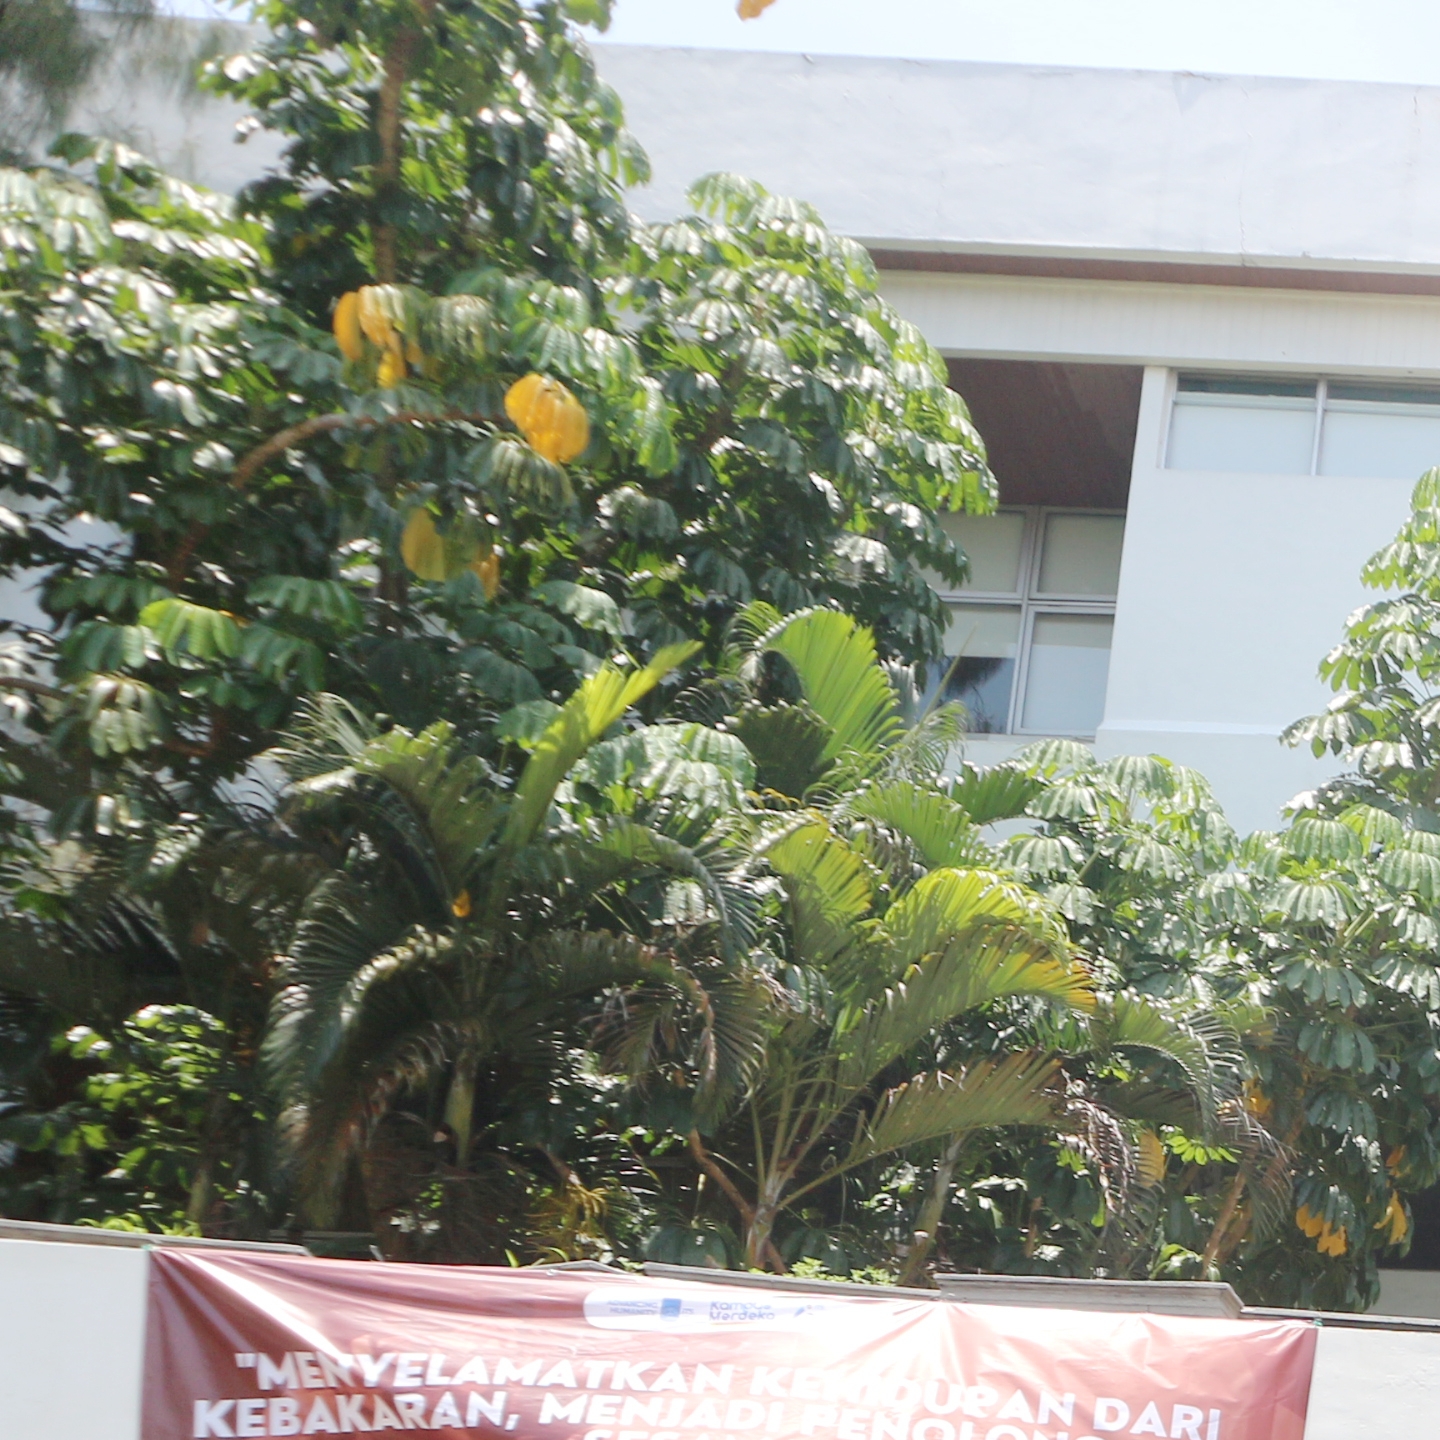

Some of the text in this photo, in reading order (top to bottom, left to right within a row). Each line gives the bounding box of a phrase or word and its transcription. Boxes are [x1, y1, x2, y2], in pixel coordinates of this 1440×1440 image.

[193, 1391, 520, 1438] KEBAKARAN,
[538, 1392, 784, 1432] MENJADI
[234, 1351, 735, 1395] "MENYELAMATKAN
[751, 1366, 1076, 1426] KEDUPAN
